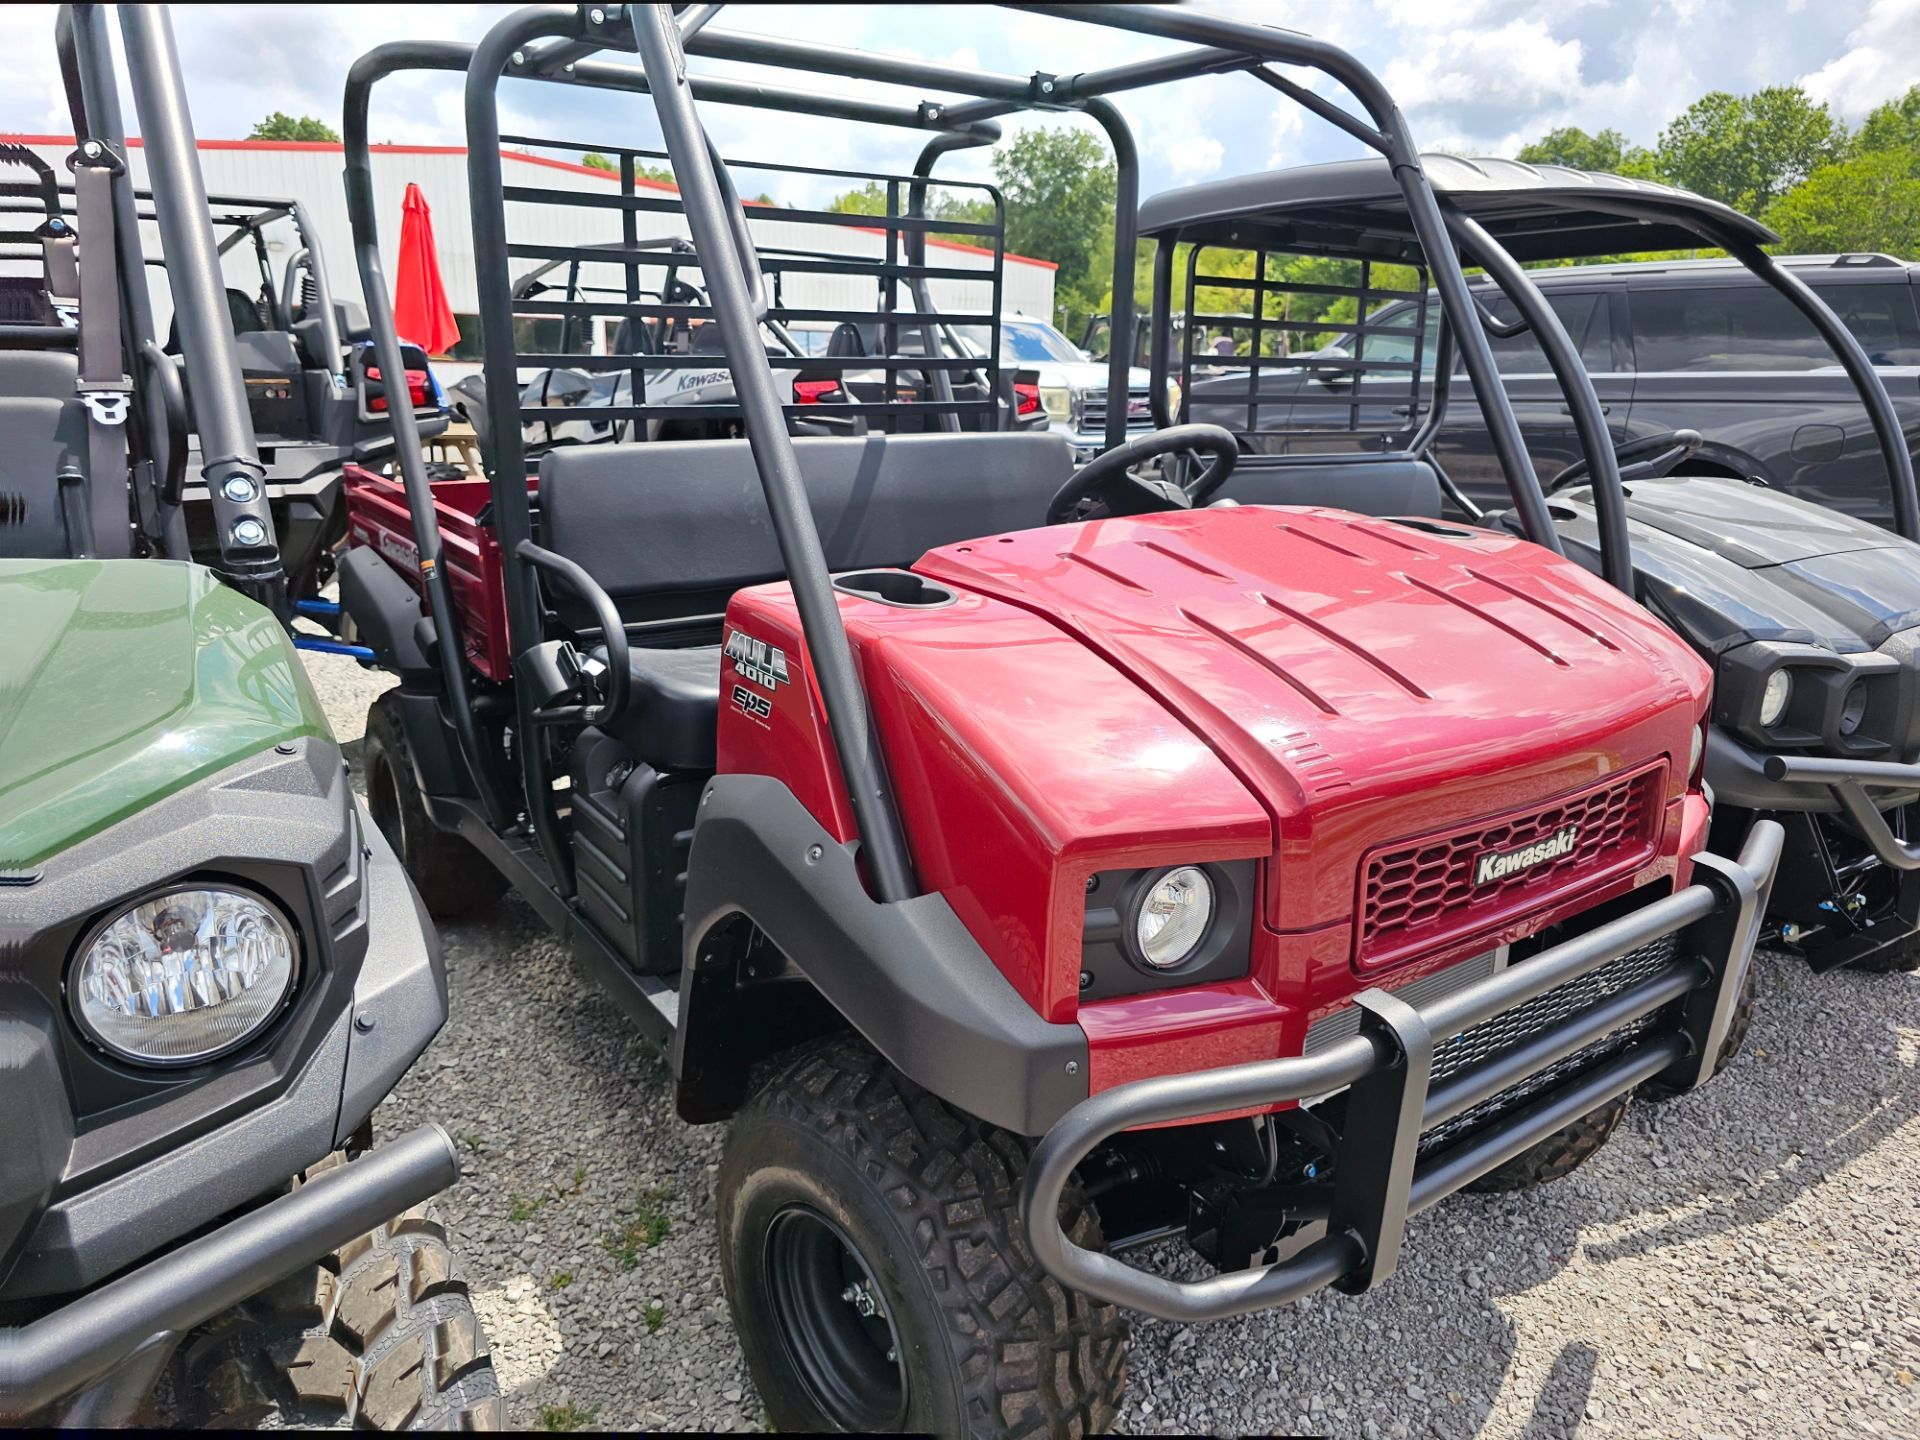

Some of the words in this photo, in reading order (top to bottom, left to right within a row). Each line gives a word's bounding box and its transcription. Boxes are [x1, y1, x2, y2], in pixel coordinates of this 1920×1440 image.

[723, 630, 791, 685] MULE
[734, 662, 777, 692] 4010
[1477, 826, 1577, 885] Kawasaki
